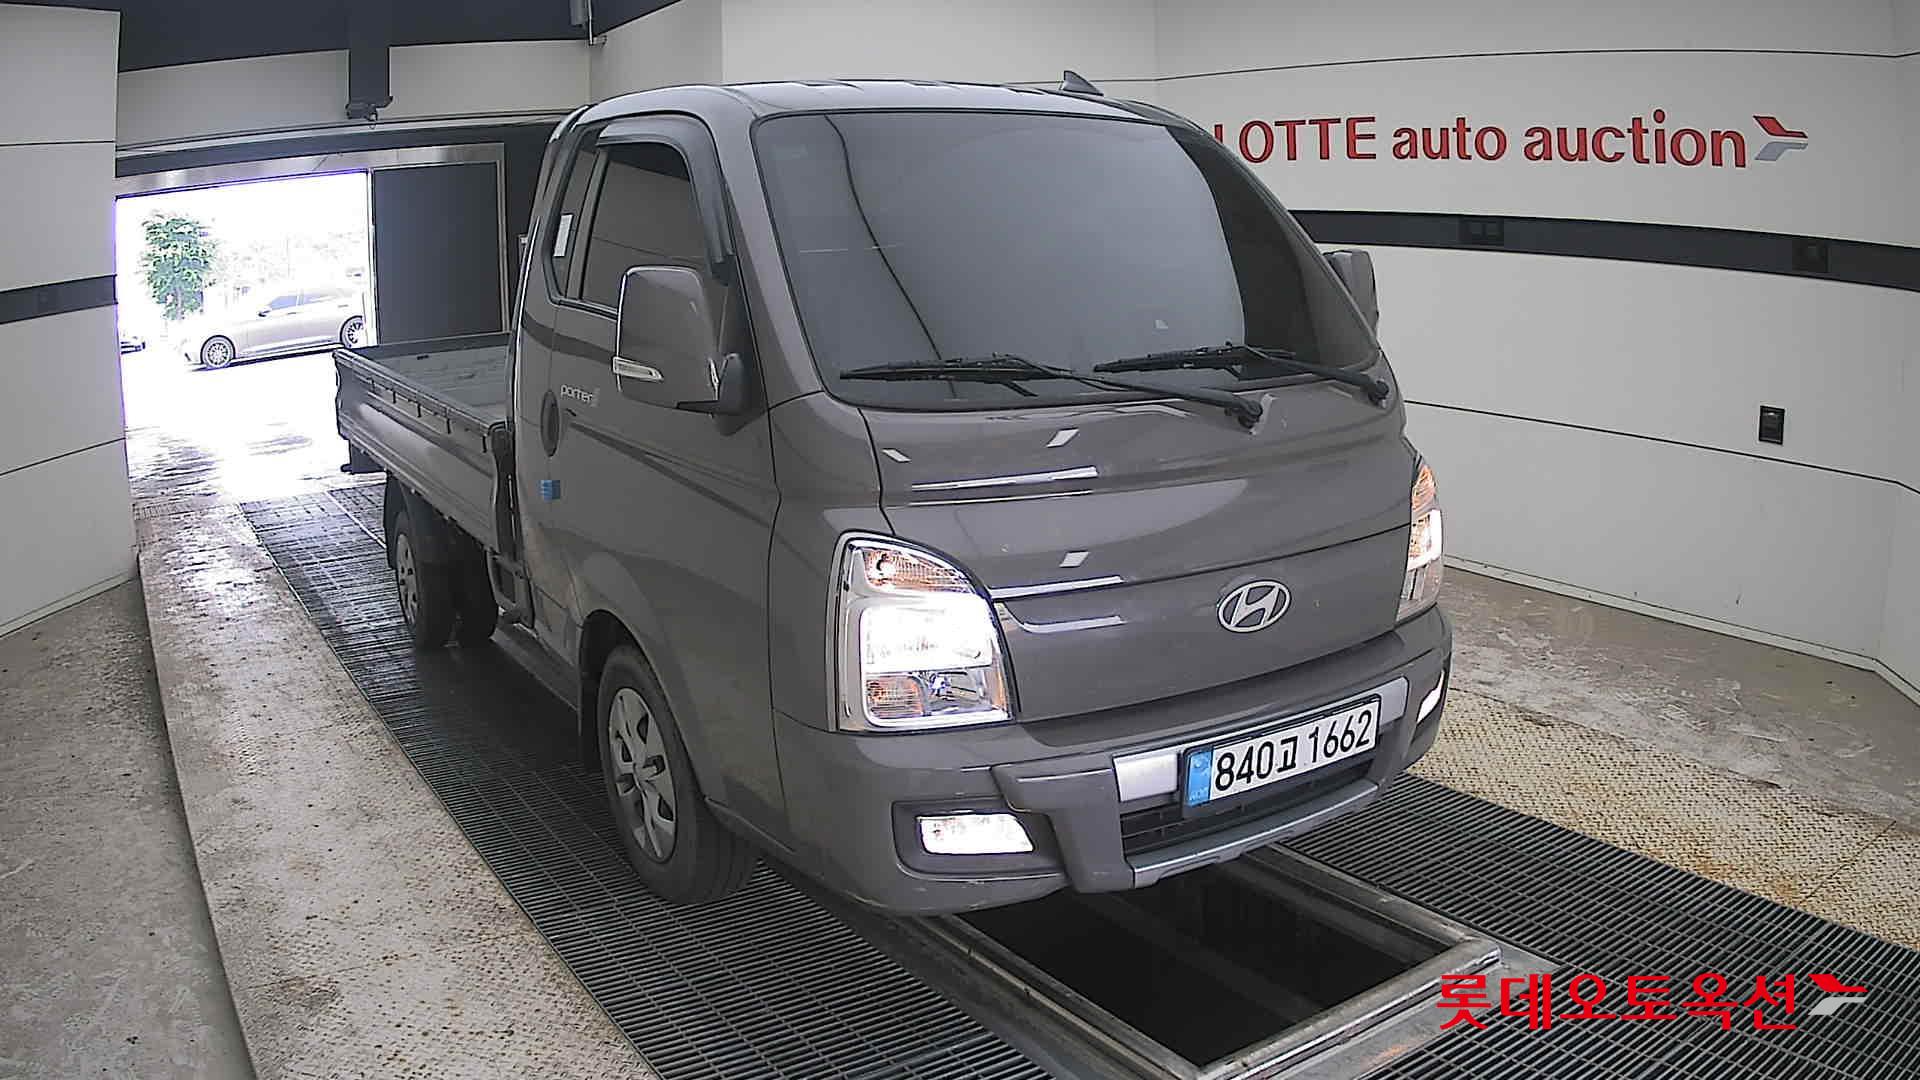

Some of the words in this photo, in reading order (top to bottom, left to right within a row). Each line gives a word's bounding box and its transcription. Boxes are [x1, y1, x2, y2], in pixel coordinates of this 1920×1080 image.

[1392, 116, 1508, 161] auto
[1523, 109, 1747, 168] auction
[1214, 735, 1298, 792] 840고
[1309, 709, 1372, 763] 1662
